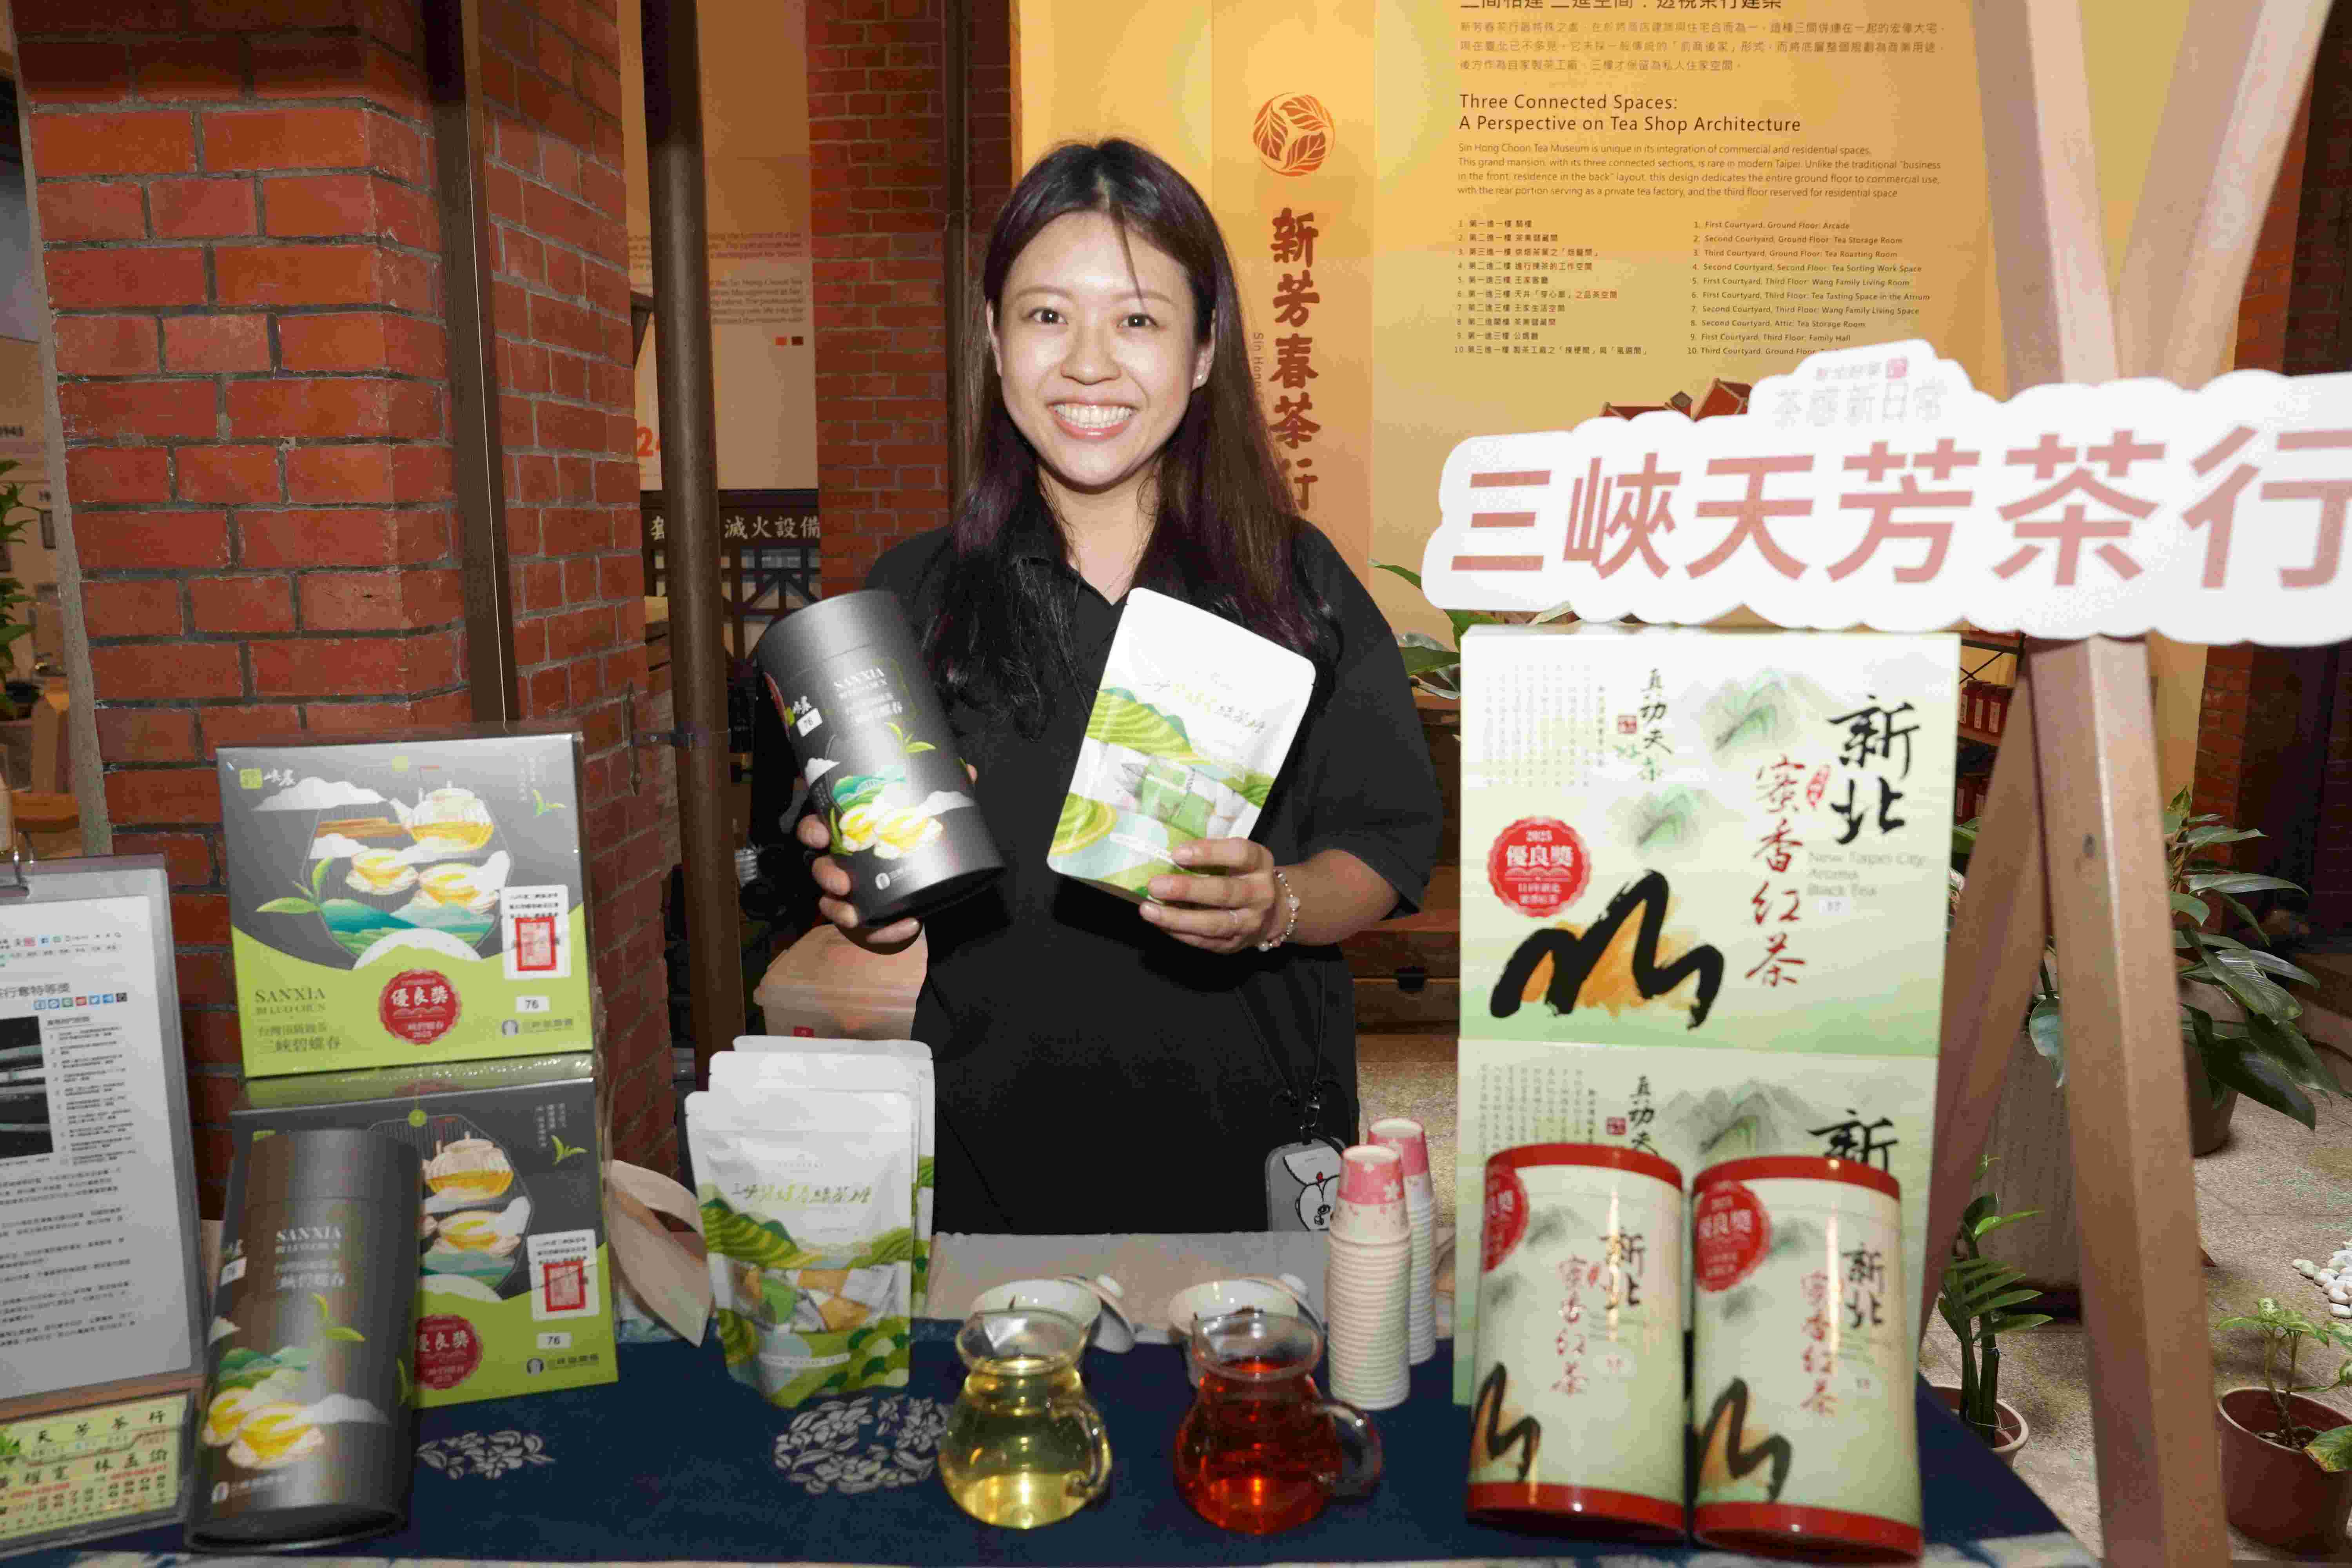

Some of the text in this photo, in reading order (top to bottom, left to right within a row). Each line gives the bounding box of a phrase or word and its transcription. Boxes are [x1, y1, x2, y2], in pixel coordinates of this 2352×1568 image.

[1459, 94, 1677, 113] Three Connected Spaces:
[1459, 116, 1800, 135] A Perspective on Tea Shop Architecture
[1458, 143, 1472, 152] Sin
[1474, 143, 1499, 154] Hong
[1501, 143, 1532, 152] Choon
[1533, 143, 1548, 152] Tea
[1550, 144, 1589, 152] Museum
[1592, 144, 1599, 152] is
[1601, 144, 1632, 155] unique
[1634, 144, 1642, 153] in
[1644, 144, 1655, 153] its
[1656, 145, 1706, 156] integration
[1707, 145, 1717, 153] of
[1719, 145, 1771, 154] commercial
[1772, 145, 1790, 154] and
[1792, 145, 1838, 154] residential
[1458, 158, 1476, 167] This
[1478, 158, 1505, 169] grand
[1549, 158, 1568, 167] with
[1571, 158, 1581, 167] its
[1583, 158, 1606, 167] three
[1608, 159, 1655, 167] connected
[1698, 159, 1705, 168] is
[1727, 159, 1735, 168] in
[1738, 159, 1773, 168] modern
[1805, 160, 1833, 168] Unlike
[1835, 160, 1850, 168] the
[1851, 160, 1897, 168] traditional
[1458, 172, 1466, 180] in
[1469, 172, 1484, 180] the
[1514, 172, 1557, 181] residence
[1560, 172, 1568, 181] in
[1571, 172, 1586, 181] the
[1649, 173, 1666, 181] this
[1668, 173, 1699, 184] design
[1701, 173, 1746, 182] dedicates
[1748, 173, 1763, 182] the
[1765, 174, 1793, 182] entire
[1794, 174, 1828, 185] ground
[1831, 174, 1853, 183] floor
[1855, 174, 1865, 183] to
[1866, 174, 1919, 183] commercial
[1457, 186, 1477, 194] with
[1479, 186, 1494, 194] the
[1515, 186, 1549, 197] portion
[1550, 187, 1583, 198] serving
[1604, 187, 1635, 198] private
[1637, 187, 1651, 196] tea
[1688, 187, 1705, 196] and
[1707, 187, 1721, 196] the
[1724, 187, 1744, 196] third
[1747, 188, 1768, 196] floor
[1770, 188, 1808, 196] reserved
[1810, 188, 1823, 197] for
[1825, 188, 1870, 197] residential
[1840, 250, 1873, 260] Roasting
[1809, 334, 1833, 343] Family
[1269, 207, 1321, 511] 新芳春茶行
[1451, 425, 2352, 589] 三峽天芳茶行
[1828, 694, 1922, 845] 新北
[255, 987, 326, 1002] SANXIA
[525, 1000, 539, 1009] 76
